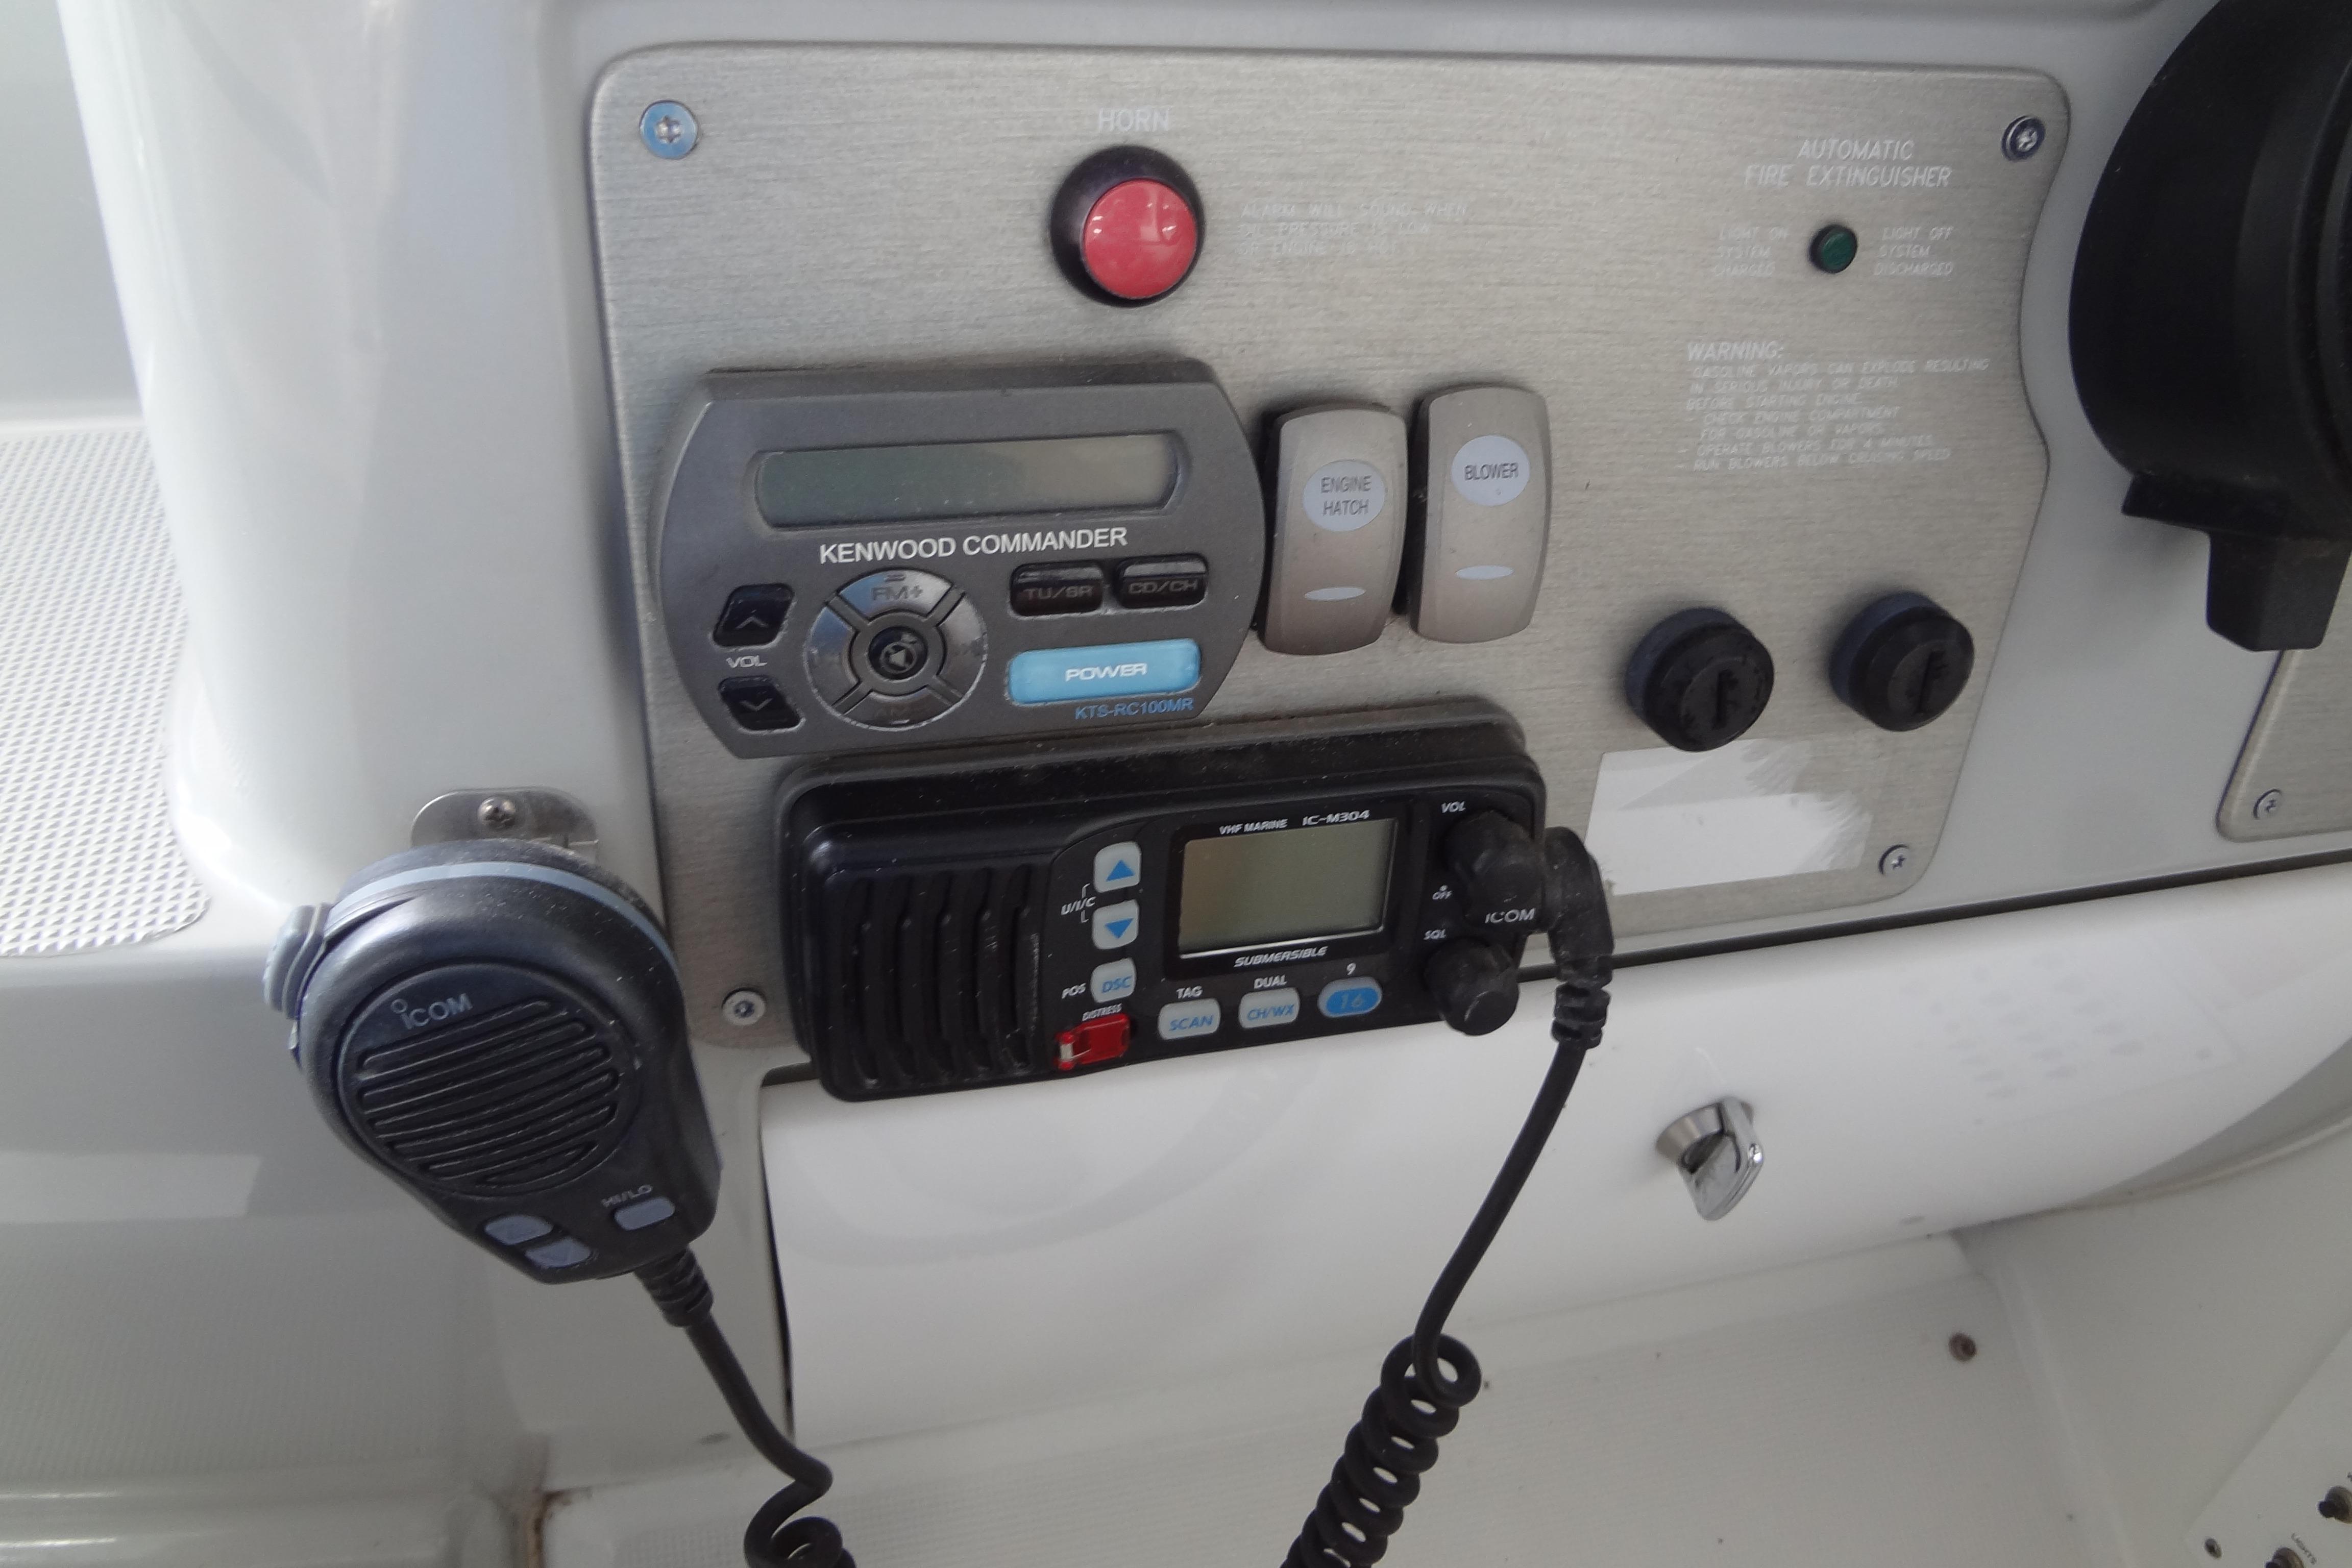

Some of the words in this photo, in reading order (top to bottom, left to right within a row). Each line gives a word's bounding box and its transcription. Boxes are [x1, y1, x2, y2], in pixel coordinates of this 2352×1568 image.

[1097, 108, 1170, 133] HORN
[1797, 139, 1915, 161] AUTOMATIC
[1745, 164, 1793, 187] FIRE
[1806, 165, 1953, 188] EXTINGUISHER
[1883, 226, 1922, 240] LIGHT
[1929, 226, 1954, 240] OFF
[1878, 244, 1930, 258] SYSTEM
[1874, 261, 1954, 276] DISCHARGED
[1687, 340, 1784, 361] WARNING:
[1464, 462, 1519, 481] BLOWER
[1320, 475, 1372, 494] ENGINE
[1322, 499, 1369, 516] HATCH
[820, 537, 956, 564] KENWOOD
[962, 527, 1128, 555] COMMANDER
[1128, 579, 1199, 594] CD/CH
[727, 654, 768, 669] VOL
[1065, 663, 1147, 682] POWER
[1074, 697, 1194, 720] KTS-RC100MR
[1441, 801, 1466, 813] VOL
[1302, 810, 1370, 826] IC-M304
[1219, 824, 1242, 835] VHF
[1243, 819, 1288, 833] MARINE
[1432, 890, 1453, 900] OFF
[1485, 908, 1536, 924] ICOM
[1424, 929, 1447, 940] SQL
[1234, 946, 1328, 967] SUBMERSIBLE
[1346, 963, 1356, 975] 9
[1101, 976, 1131, 993] DSC
[1254, 975, 1287, 989] DUAL
[1062, 983, 1087, 999] POS
[1176, 986, 1203, 999] TAG
[1339, 993, 1364, 1010] 16
[1082, 1003, 1122, 1021] DISTRESS
[1246, 1003, 1294, 1021] CH/WX
[1169, 1015, 1213, 1032] SCAN
